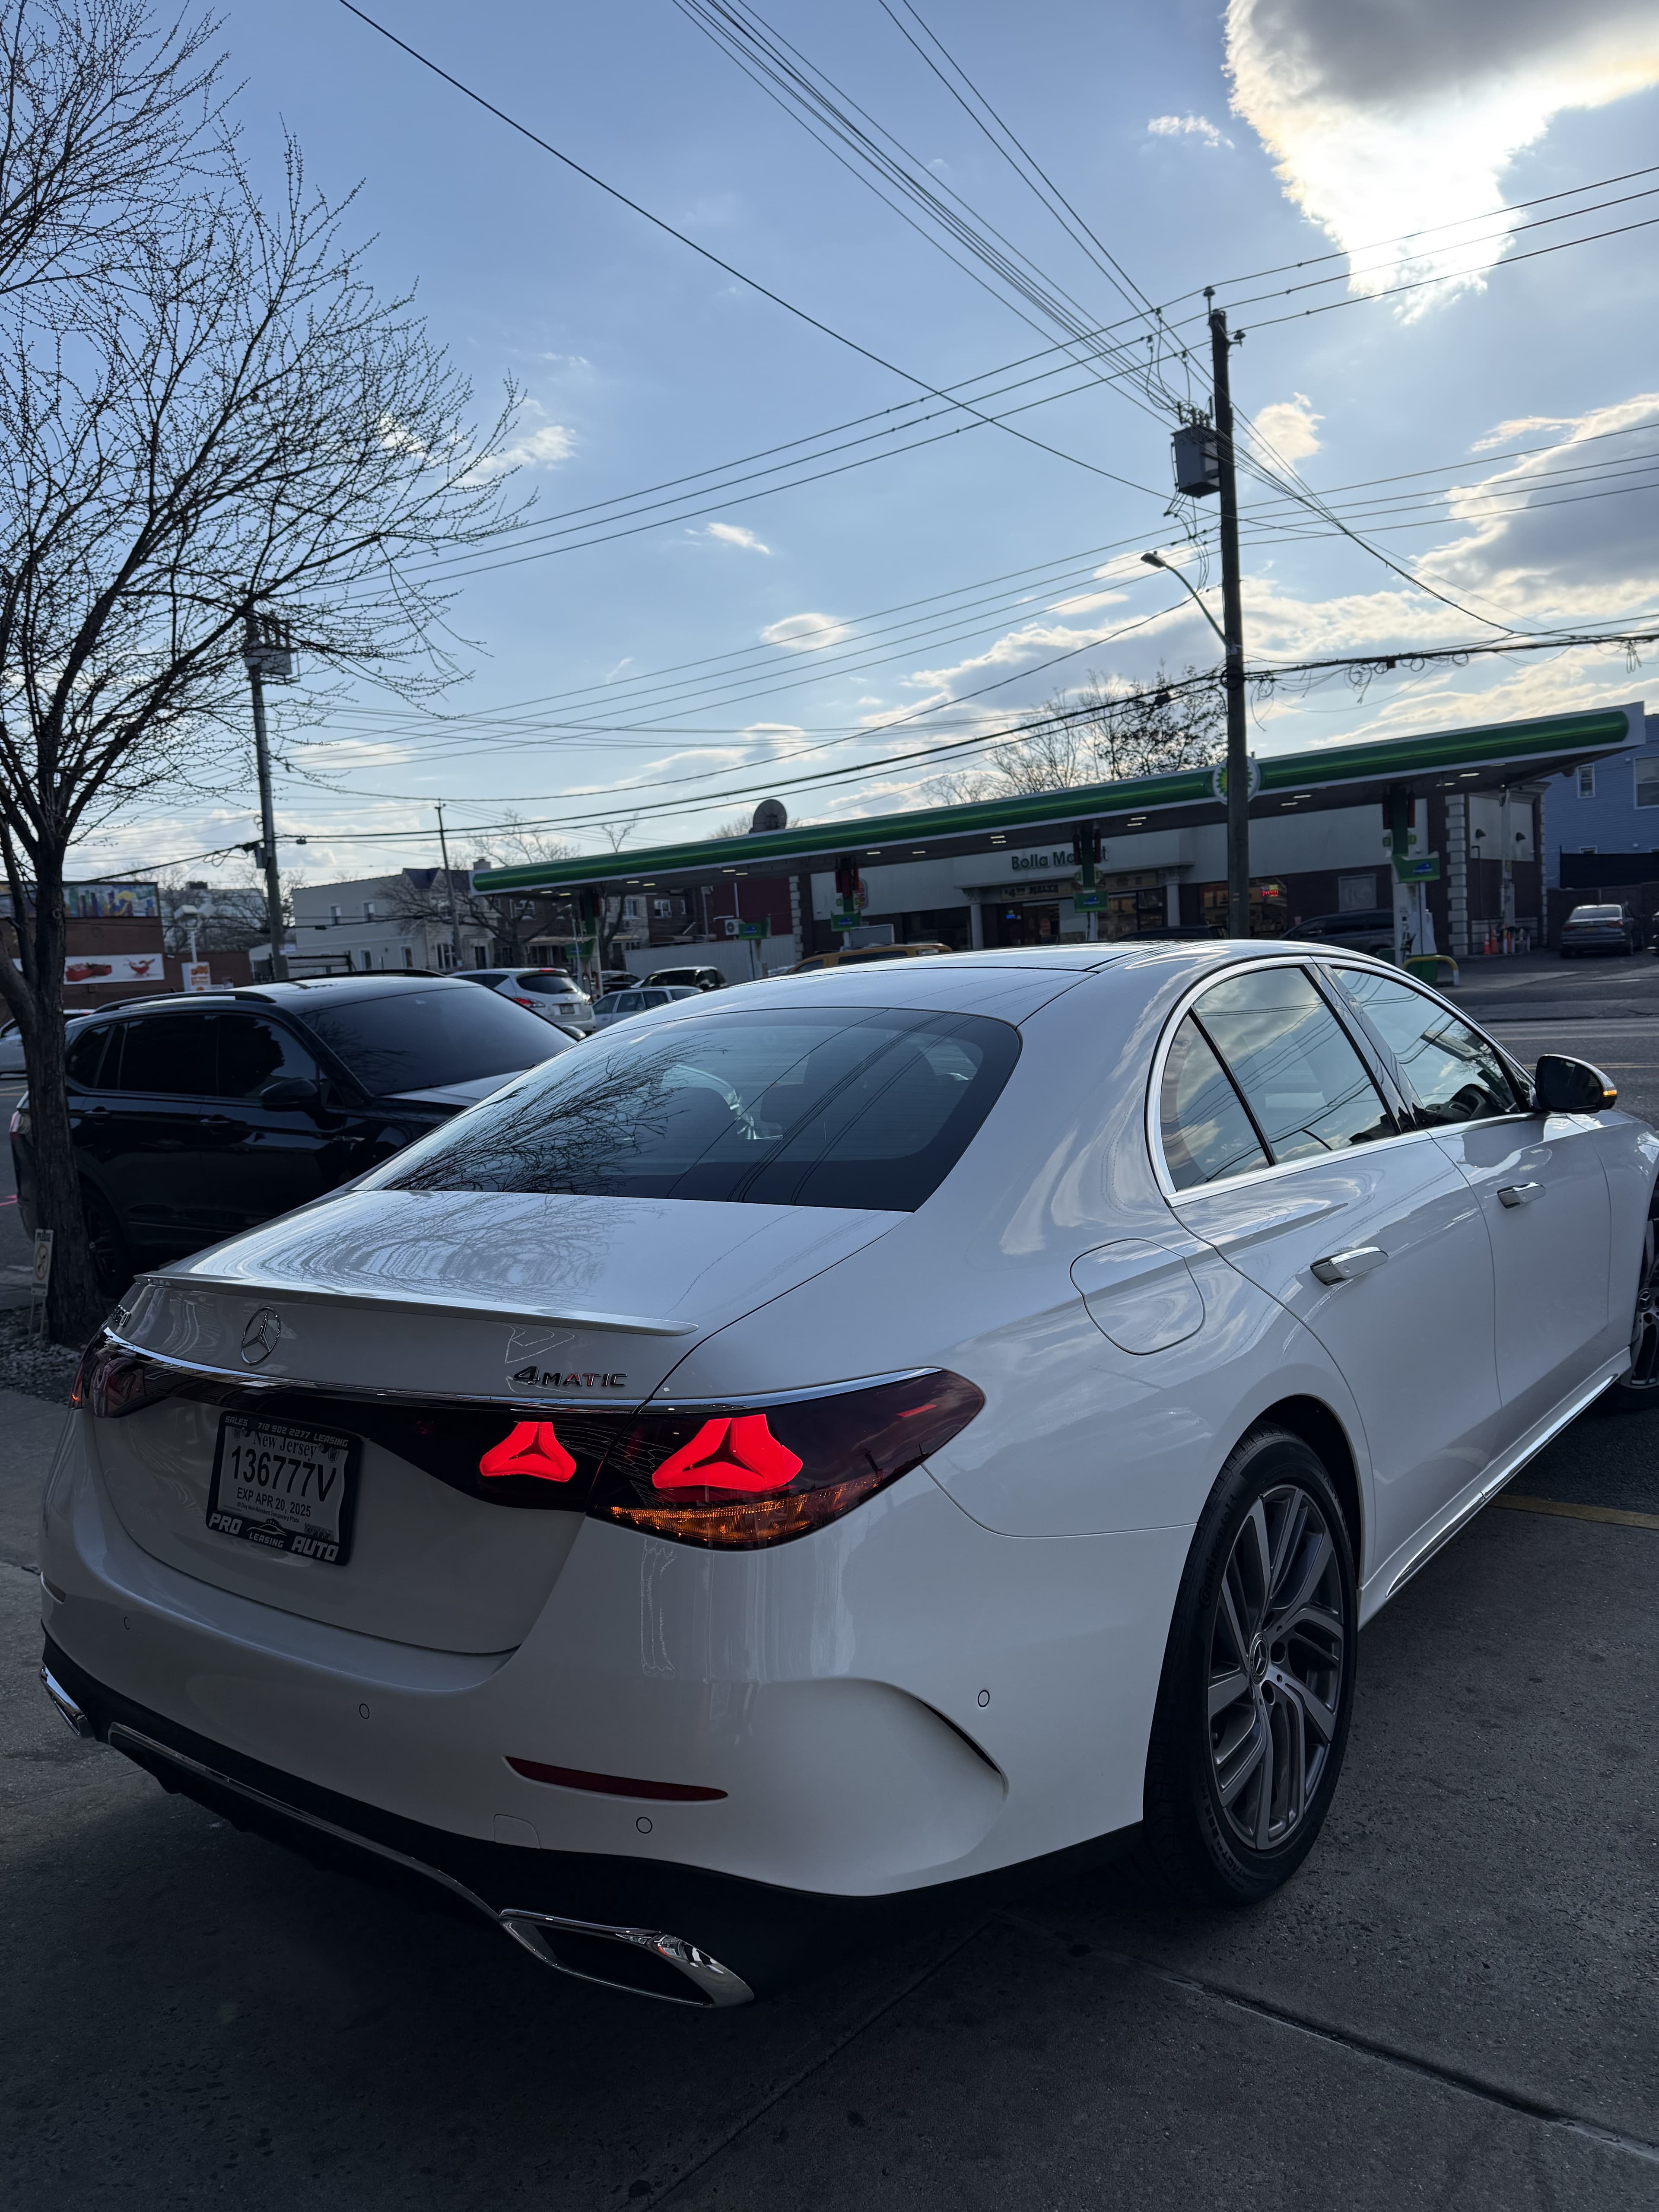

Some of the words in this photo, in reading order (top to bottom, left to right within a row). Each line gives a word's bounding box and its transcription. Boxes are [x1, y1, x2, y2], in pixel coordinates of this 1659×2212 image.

[1012, 853, 1048, 870] Bolla
[1053, 845, 1107, 865] Mat
[513, 1366, 628, 1386] 4MATIC
[225, 1415, 249, 1426] SALES
[257, 1422, 270, 1431] 718
[271, 1425, 286, 1435] 902
[289, 1428, 311, 1439] 2277
[313, 1433, 349, 1447] LEASING
[253, 1430, 278, 1449] New
[280, 1437, 317, 1462] Jersey
[232, 1446, 337, 1502] 136777V
[237, 1487, 254, 1501] EXP
[255, 1492, 273, 1508] APR
[275, 1497, 287, 1514] 20,
[290, 1501, 311, 1518] 2025
[271, 1511, 289, 1522] Temporary
[208, 1513, 243, 1535] PRO
[290, 1535, 339, 1562] AUTO
[248, 1532, 285, 1548] LEASING
